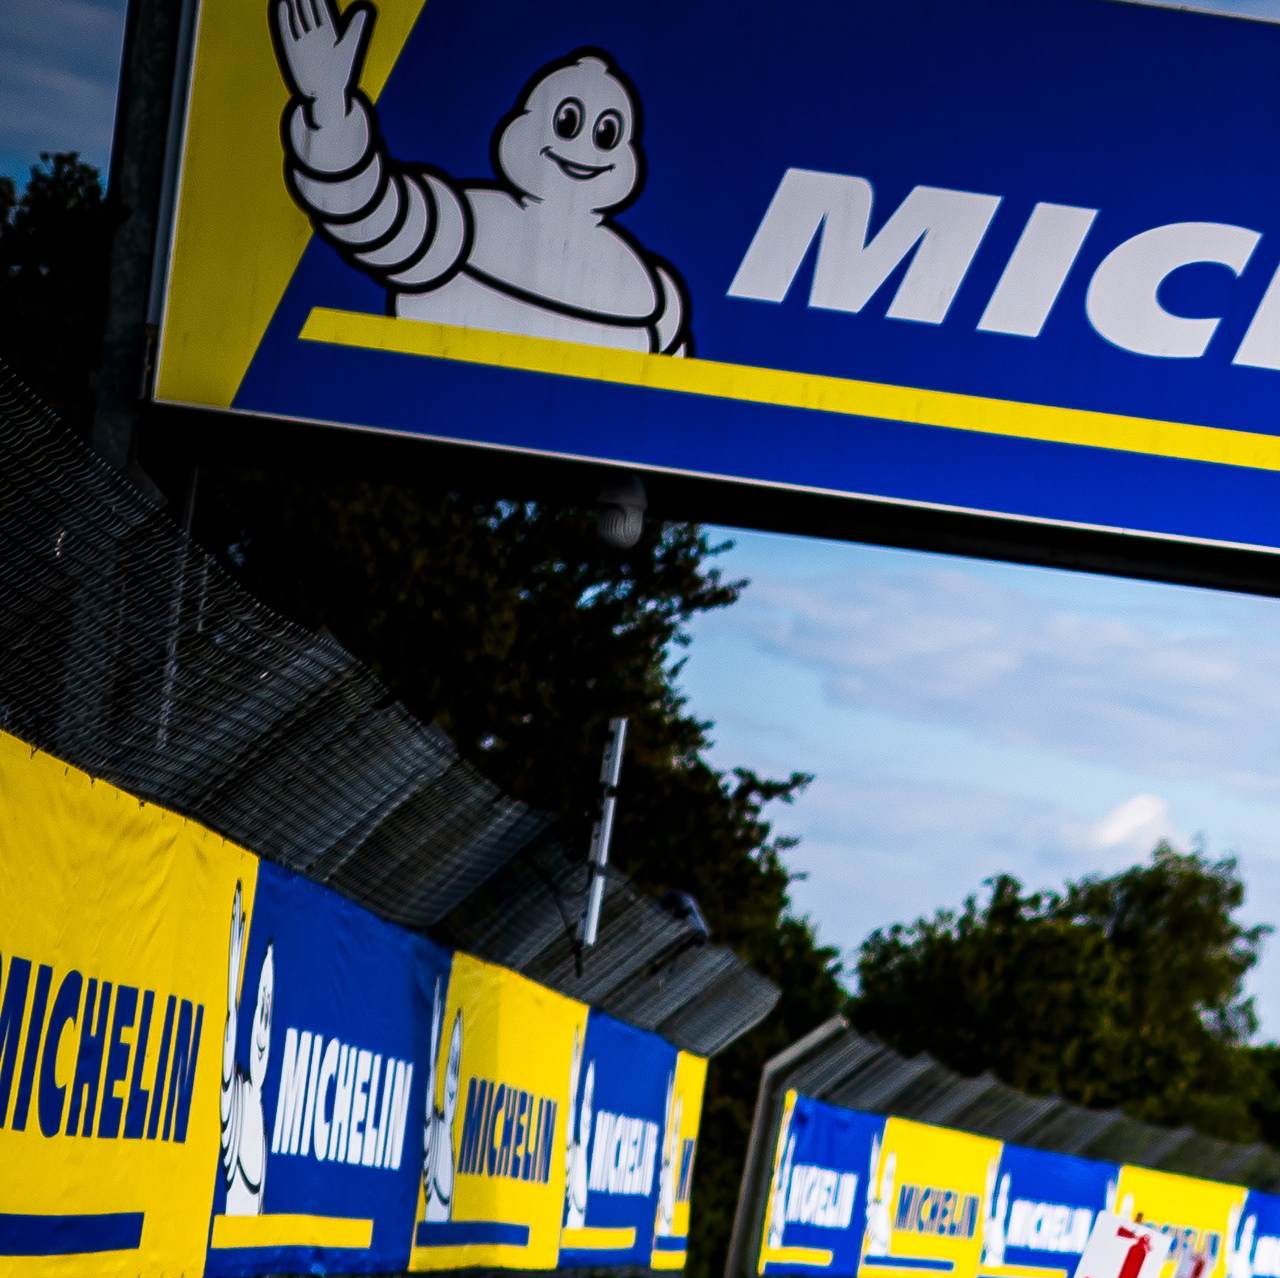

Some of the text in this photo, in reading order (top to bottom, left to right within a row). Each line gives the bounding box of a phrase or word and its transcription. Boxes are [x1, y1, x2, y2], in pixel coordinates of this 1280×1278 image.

[271, 1027, 414, 1171] MICHELIN
[457, 1077, 558, 1185] MICHELIN
[589, 1110, 659, 1198] MICHELIN
[895, 1184, 981, 1239] MICHELIN
